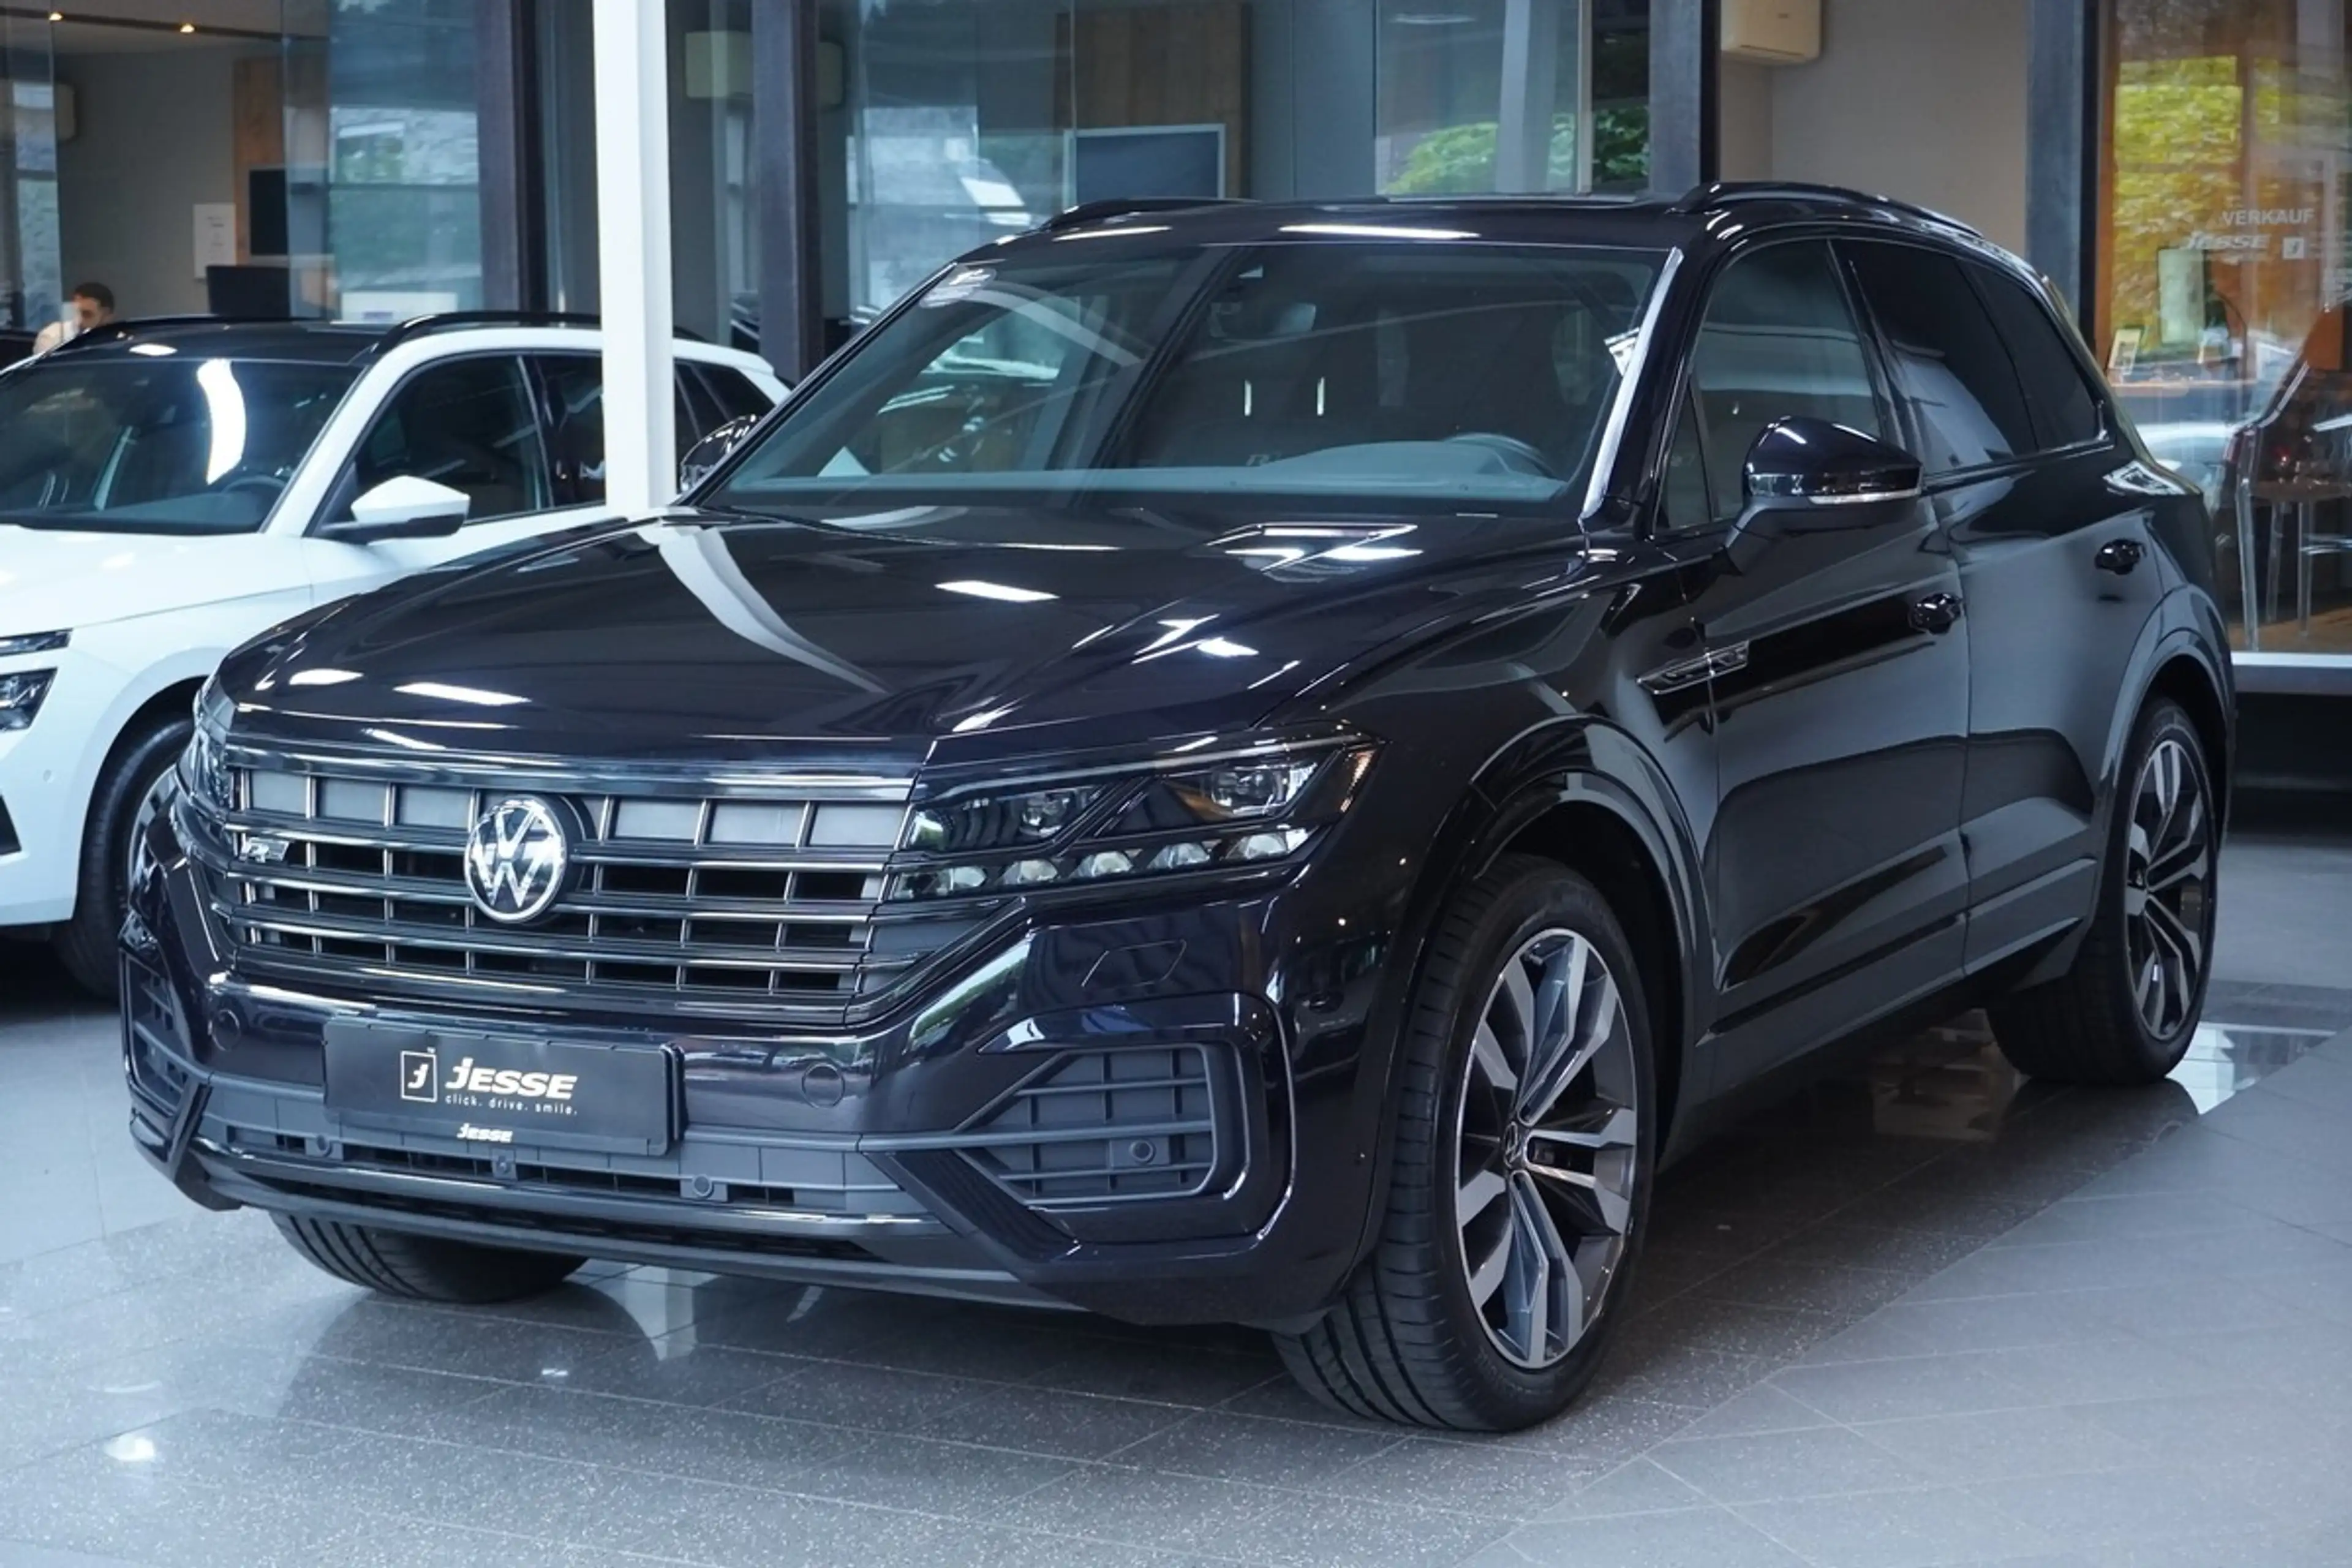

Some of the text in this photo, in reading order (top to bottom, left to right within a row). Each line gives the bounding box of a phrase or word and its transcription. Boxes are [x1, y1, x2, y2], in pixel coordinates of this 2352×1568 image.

[2222, 209, 2315, 225] VERKAUF
[445, 1094, 578, 1115] click. drive. smile.
